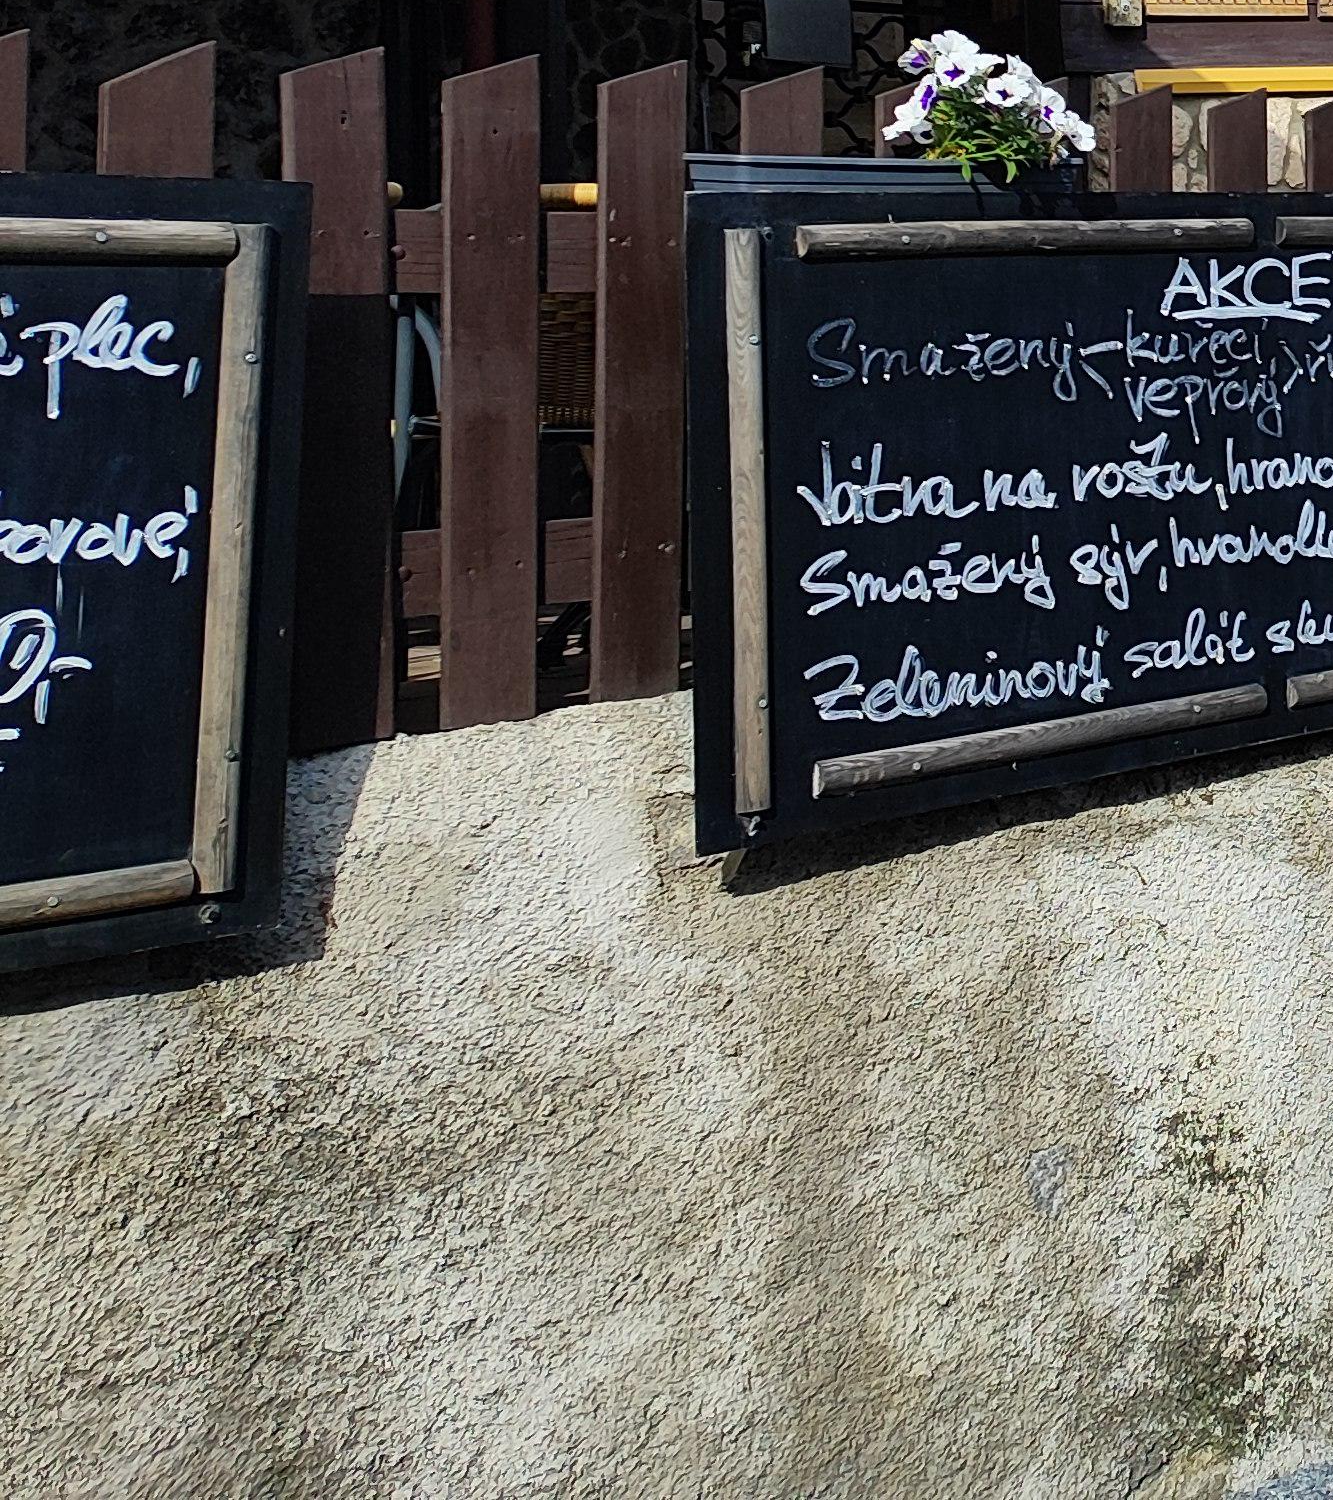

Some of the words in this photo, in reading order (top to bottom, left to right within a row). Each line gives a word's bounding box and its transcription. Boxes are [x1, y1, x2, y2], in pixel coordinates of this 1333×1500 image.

[807, 318, 1079, 401] Smažený
[983, 468, 1059, 512] na
[799, 534, 1056, 616] Smažený
